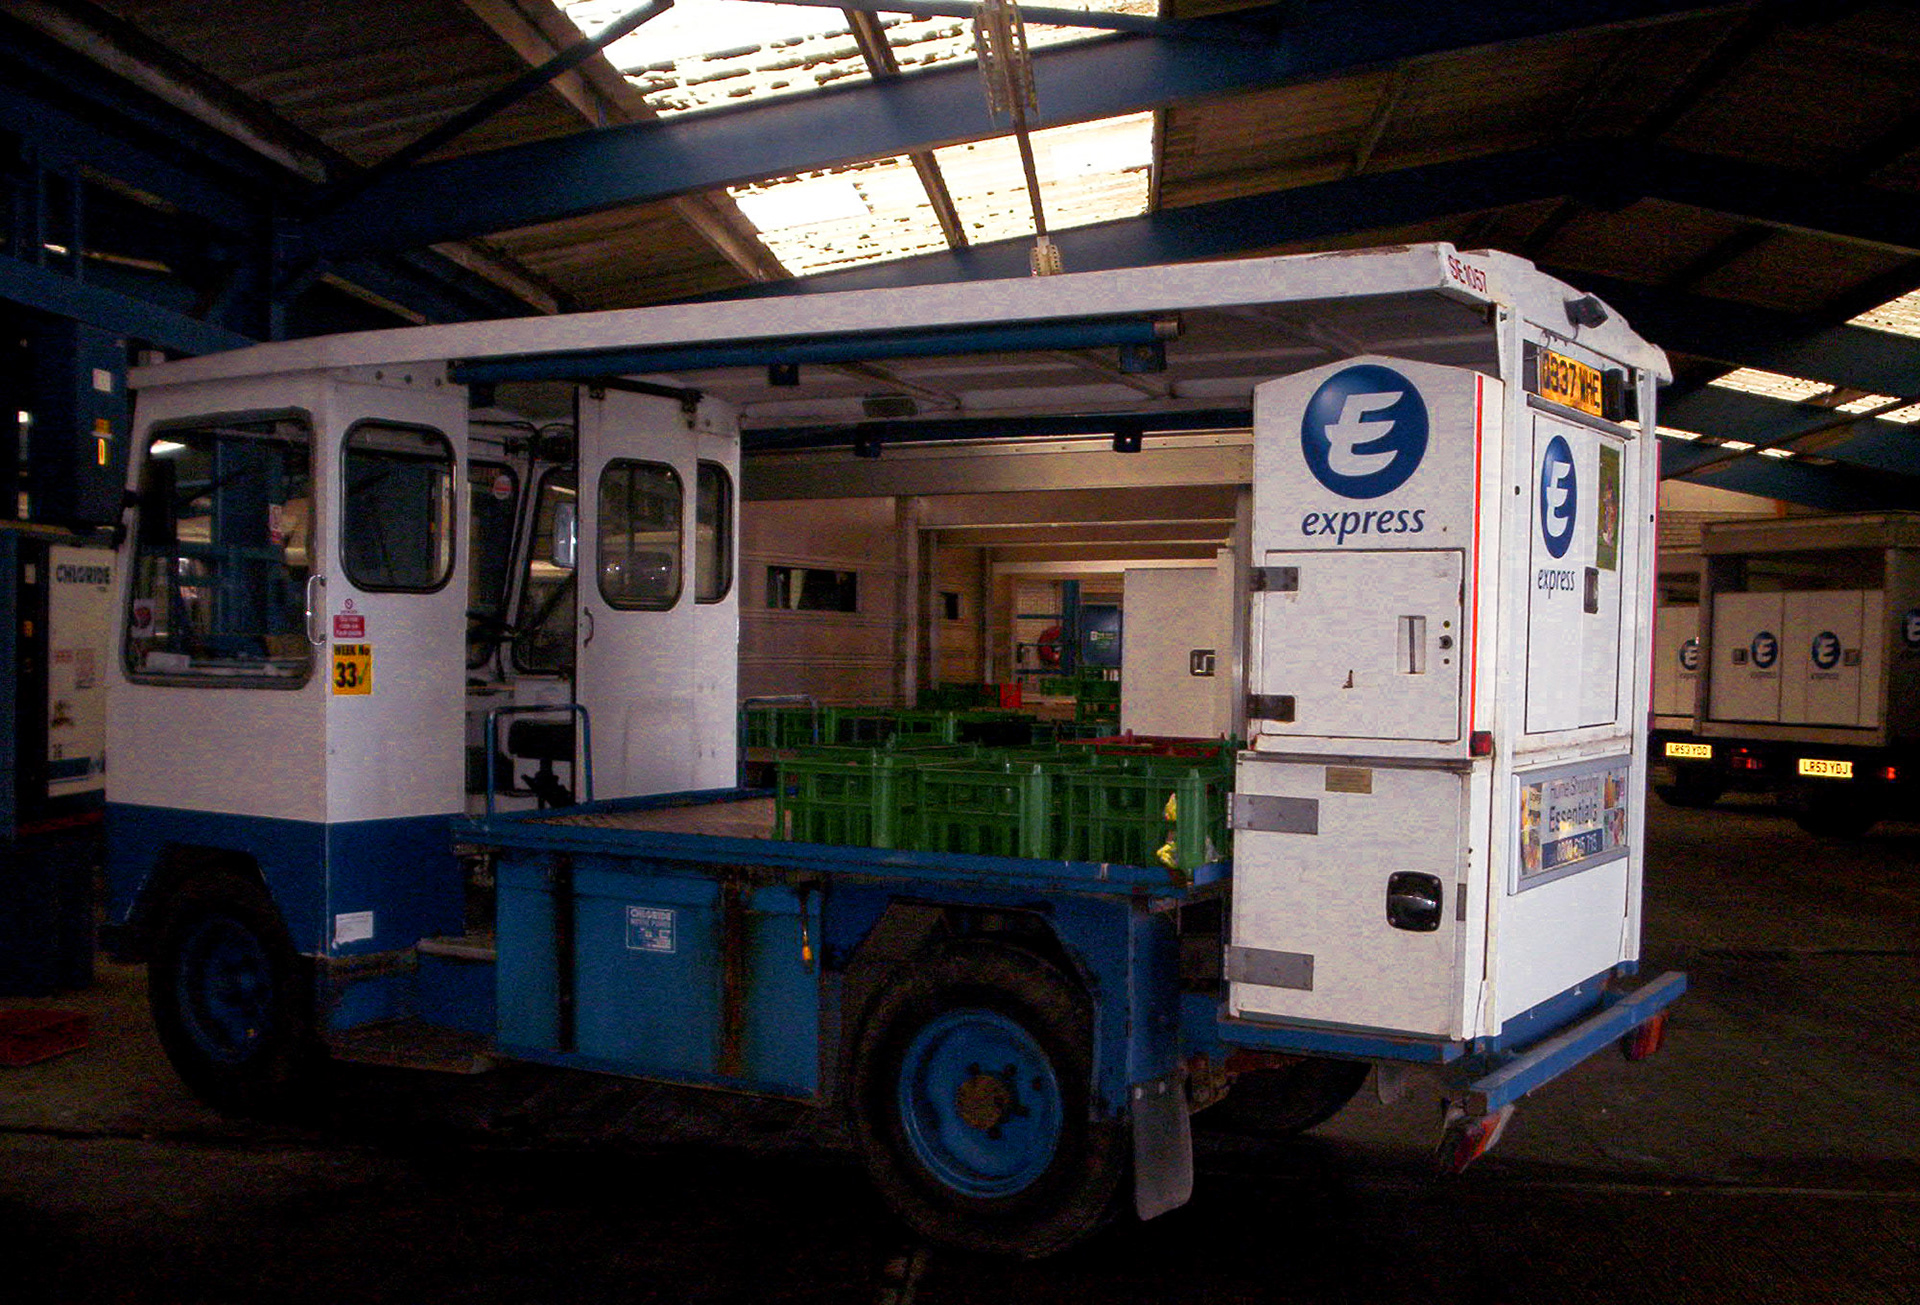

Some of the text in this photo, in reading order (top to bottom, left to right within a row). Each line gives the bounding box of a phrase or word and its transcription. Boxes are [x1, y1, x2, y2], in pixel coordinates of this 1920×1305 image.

[1447, 254, 1488, 294] SE1057
[1301, 508, 1426, 545] express
[55, 564, 111, 584] CHLORIDE
[1537, 569, 1576, 599] express
[334, 644, 356, 656] WEEK
[334, 660, 357, 688] 33
[1803, 761, 1828, 774] LR53
[1549, 798, 1598, 833] Essentials
